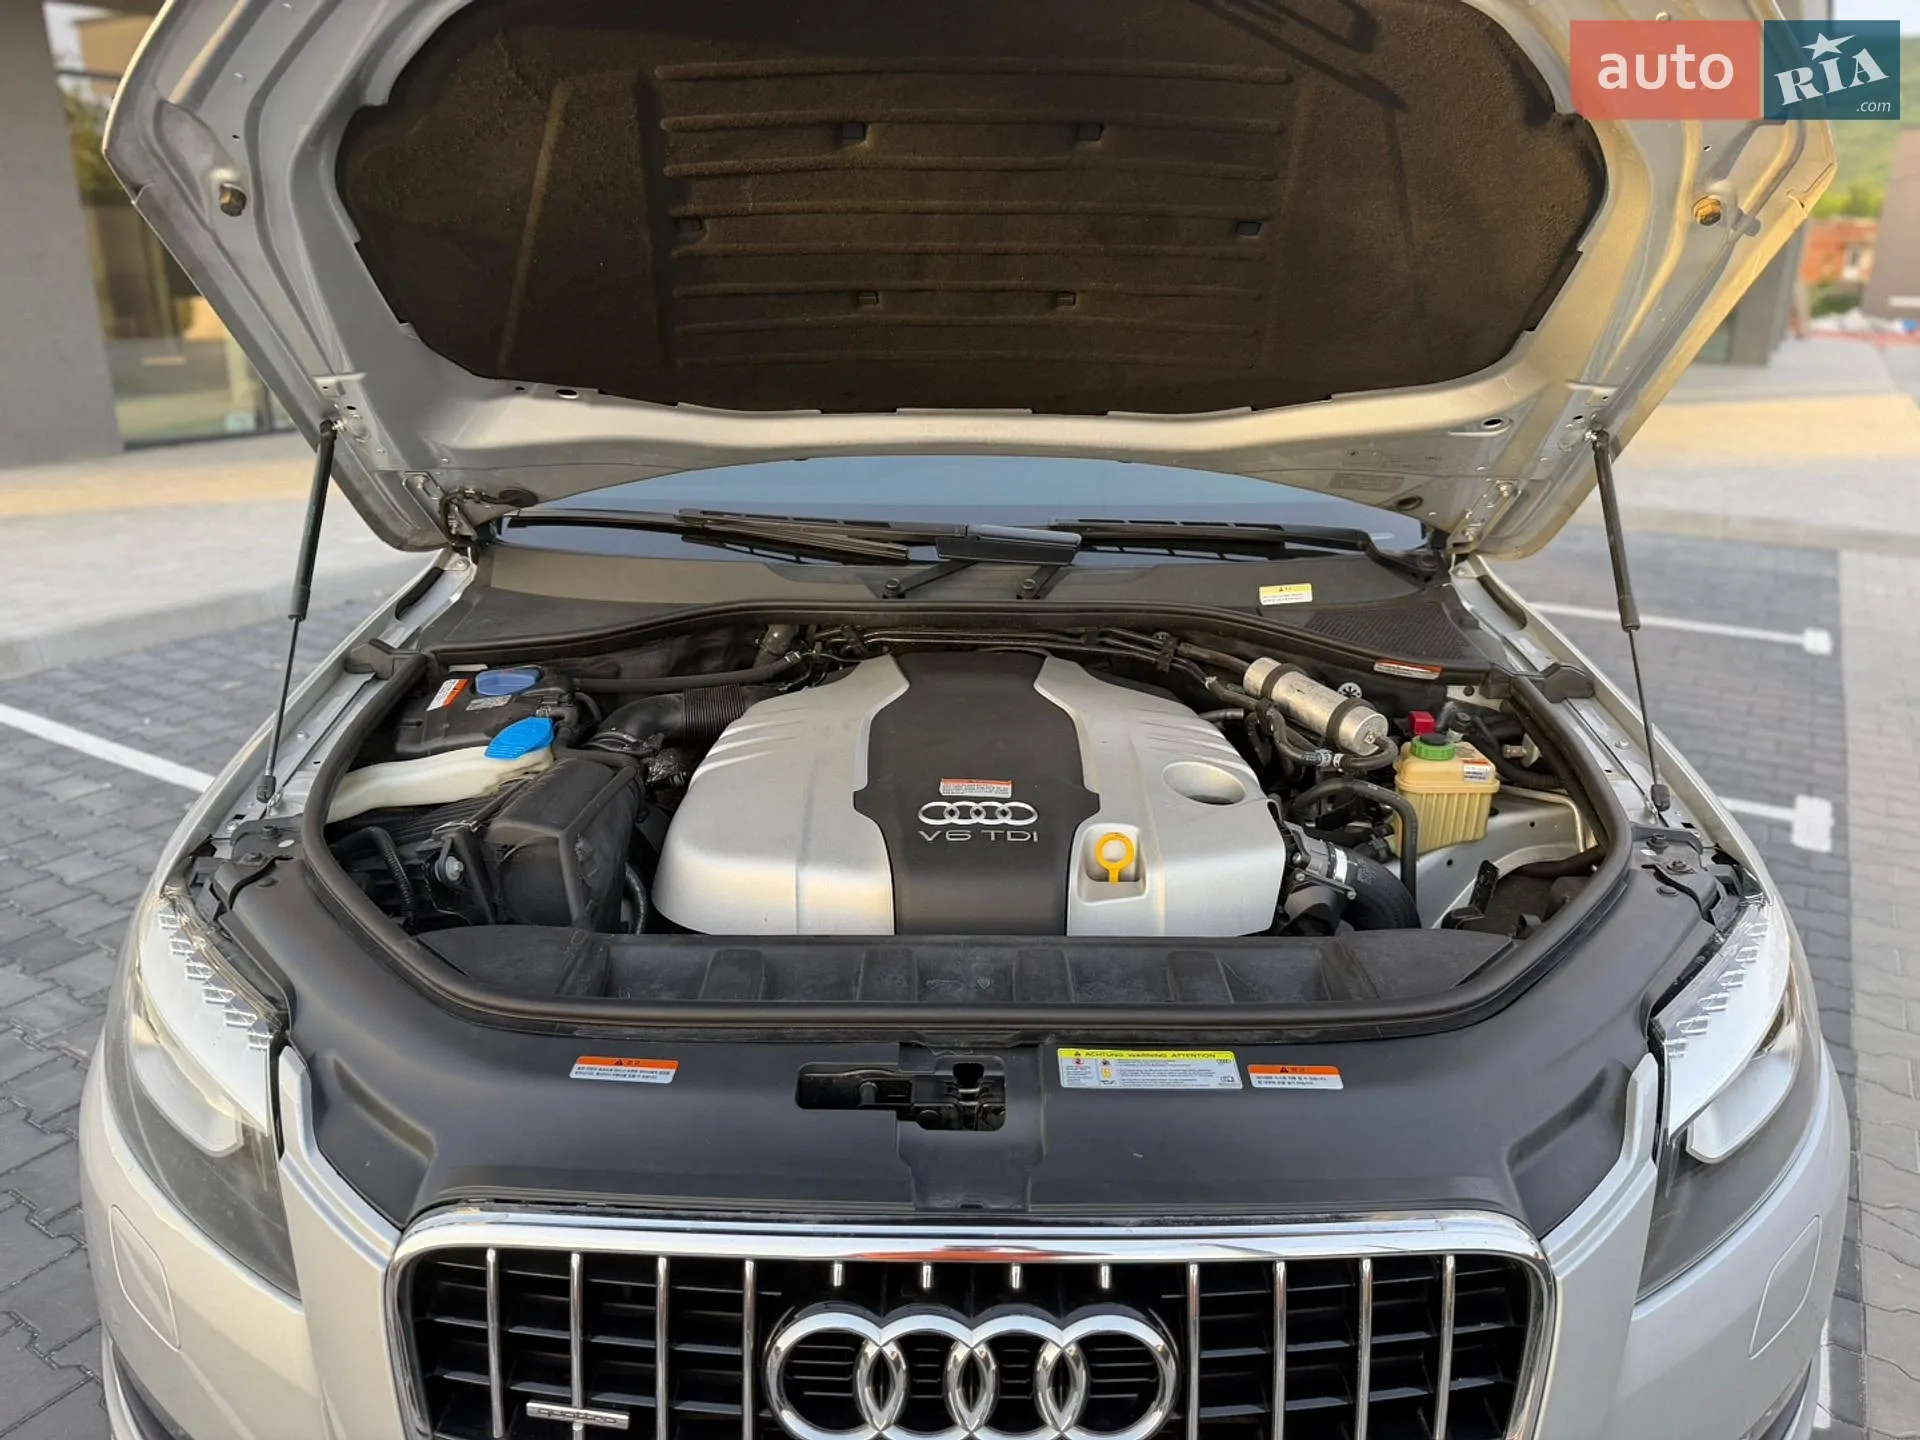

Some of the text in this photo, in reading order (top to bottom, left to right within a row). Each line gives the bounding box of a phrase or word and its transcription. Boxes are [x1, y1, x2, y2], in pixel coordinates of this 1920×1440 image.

[918, 829, 1039, 843] V6 TDI
[537, 1408, 617, 1424] quattro
